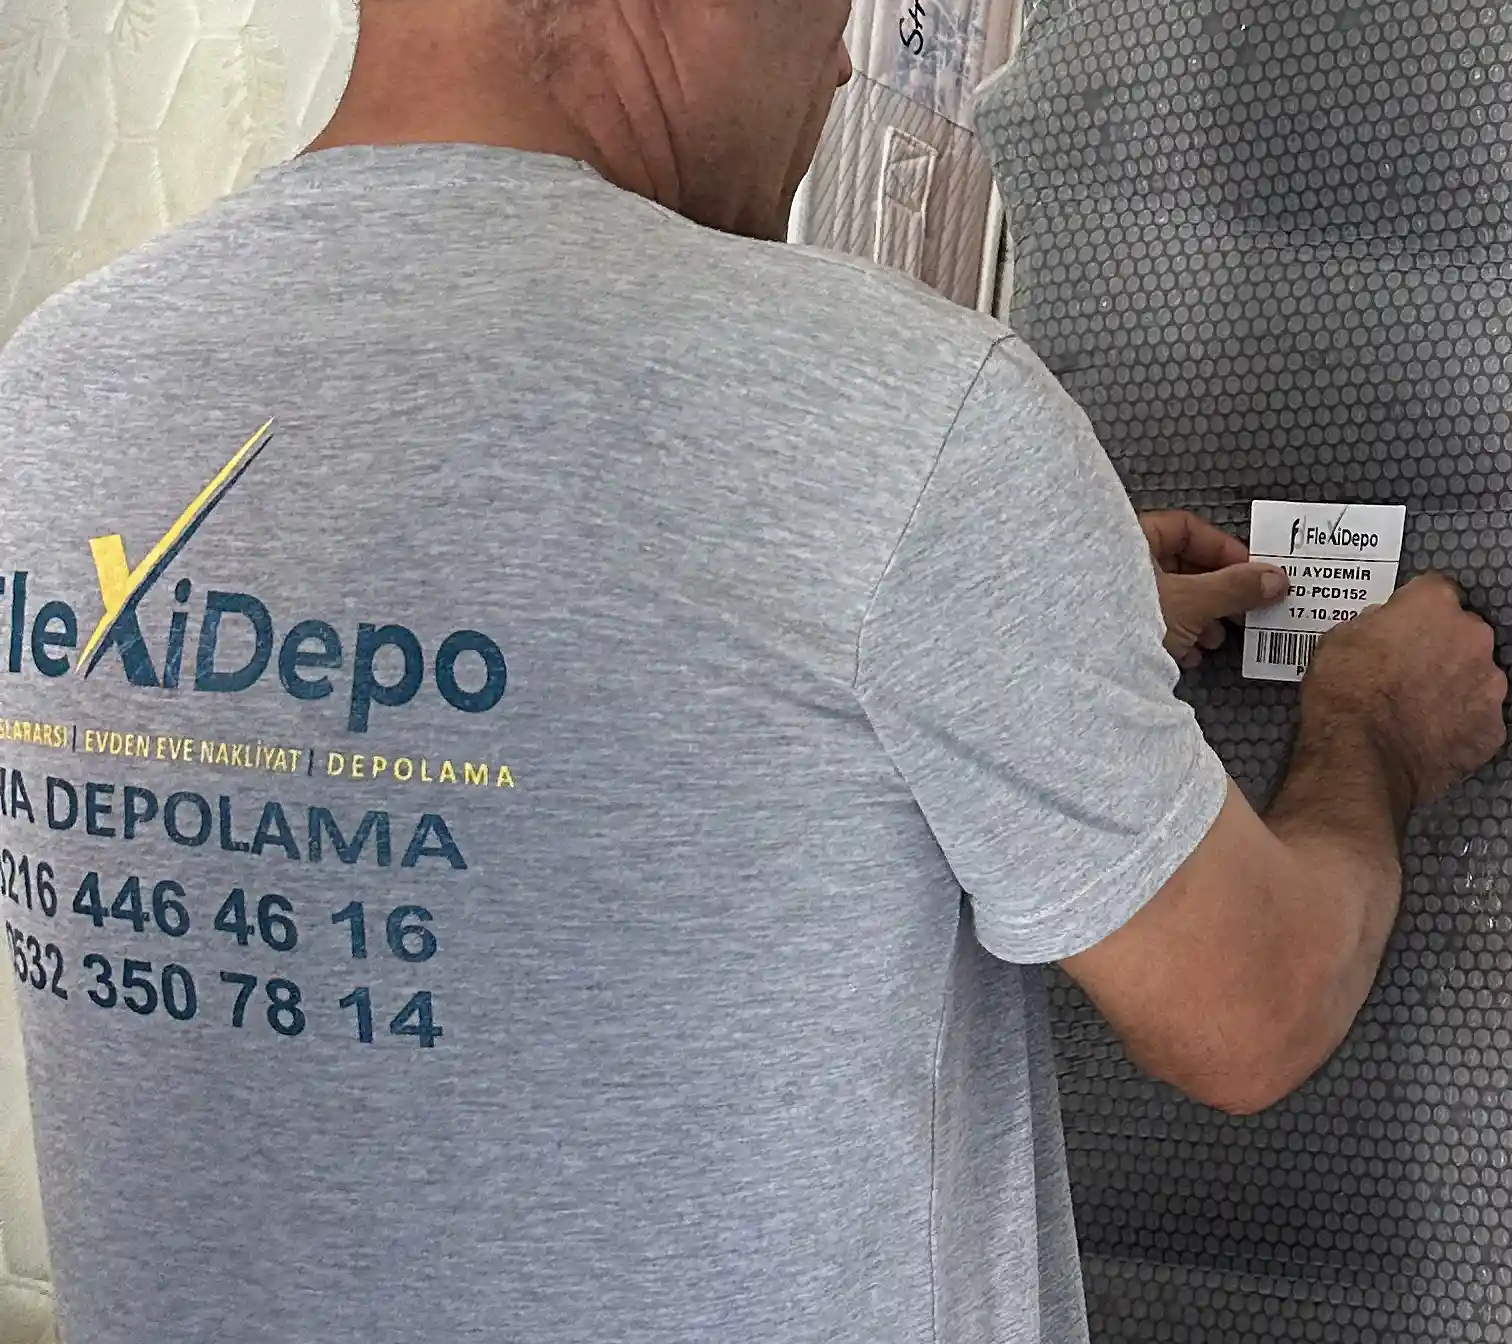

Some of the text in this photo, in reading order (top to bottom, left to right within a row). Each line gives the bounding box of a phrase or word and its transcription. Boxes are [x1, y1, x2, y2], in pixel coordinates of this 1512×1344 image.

[1302, 566, 1371, 581] AYDEMİR
[1289, 607, 1358, 622] 17.10.202
[84, 729, 150, 758] EVDEN
[156, 735, 194, 761] EVE
[200, 739, 301, 773] NAKLİYAT
[327, 752, 515, 788] DEPOLAMA
[46, 775, 468, 870] DEPOLAMA
[72, 872, 191, 937] 446
[213, 888, 298, 952] 46
[331, 901, 437, 963] 16
[83, 953, 198, 1021] 350
[219, 970, 306, 1037] 78
[339, 986, 443, 1048] 14
